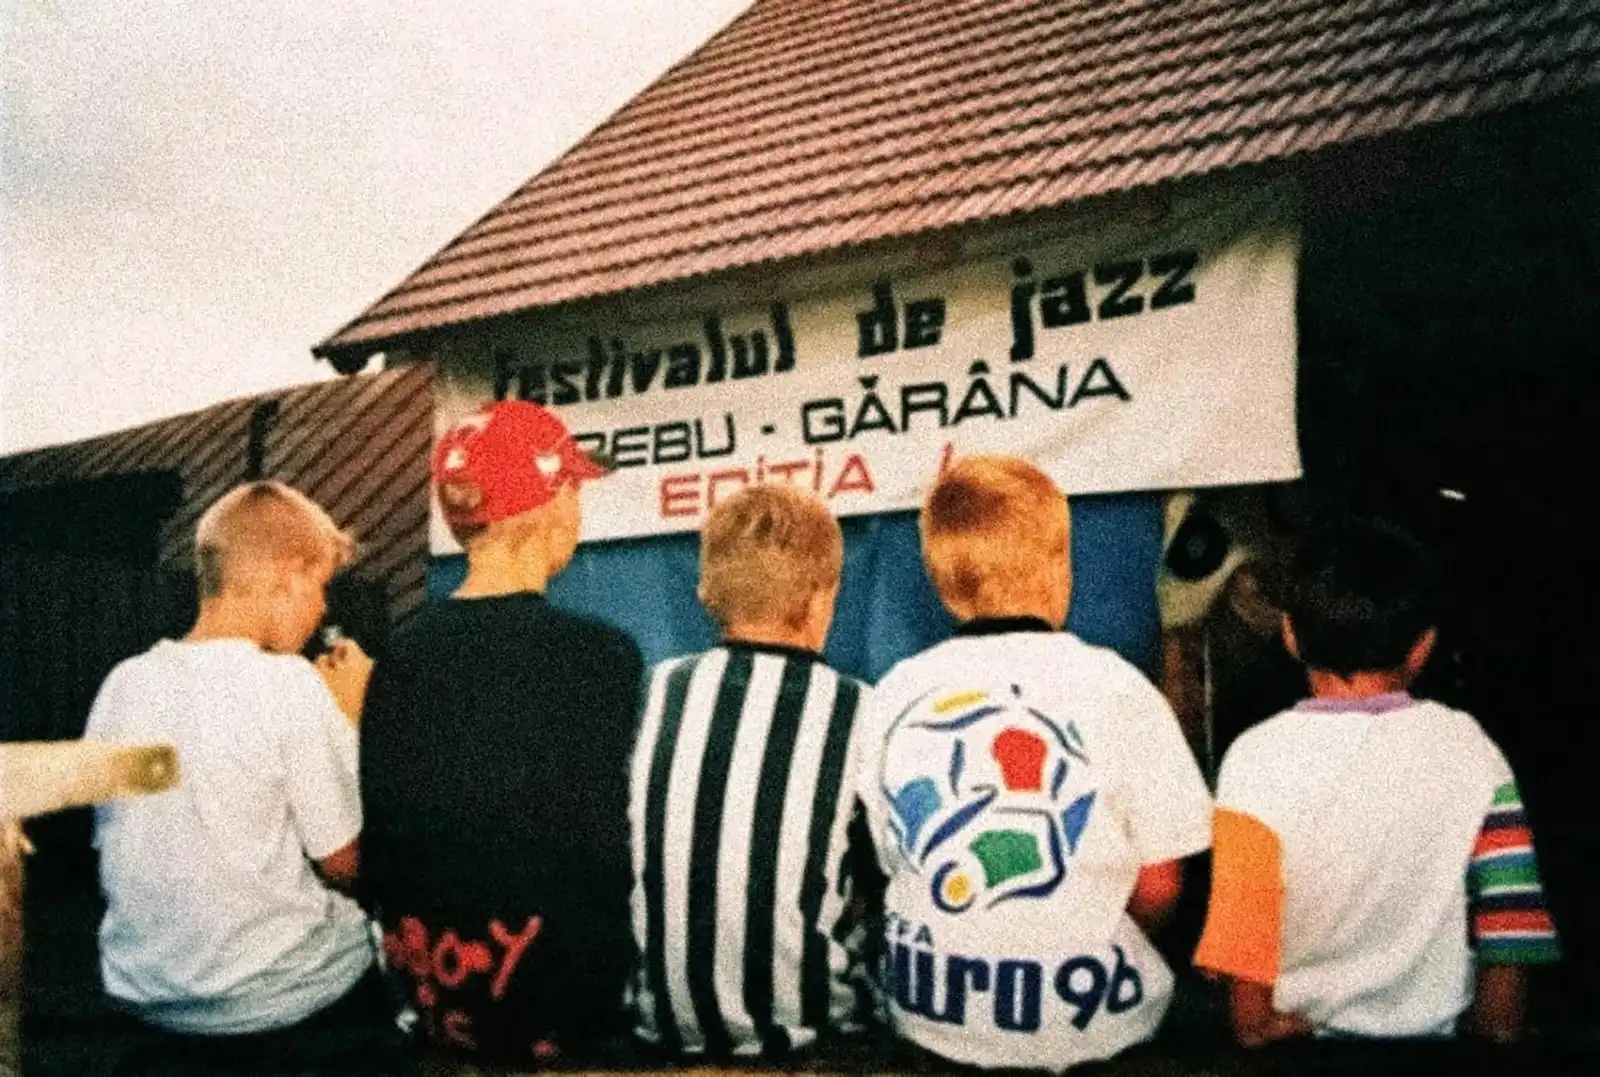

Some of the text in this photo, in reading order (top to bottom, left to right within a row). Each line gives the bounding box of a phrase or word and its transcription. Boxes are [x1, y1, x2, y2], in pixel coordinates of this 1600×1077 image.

[857, 272, 946, 359] de
[1009, 250, 1199, 362] jazz
[802, 356, 1133, 446] GĂRÂNA
[1054, 944, 1144, 1032] 96
